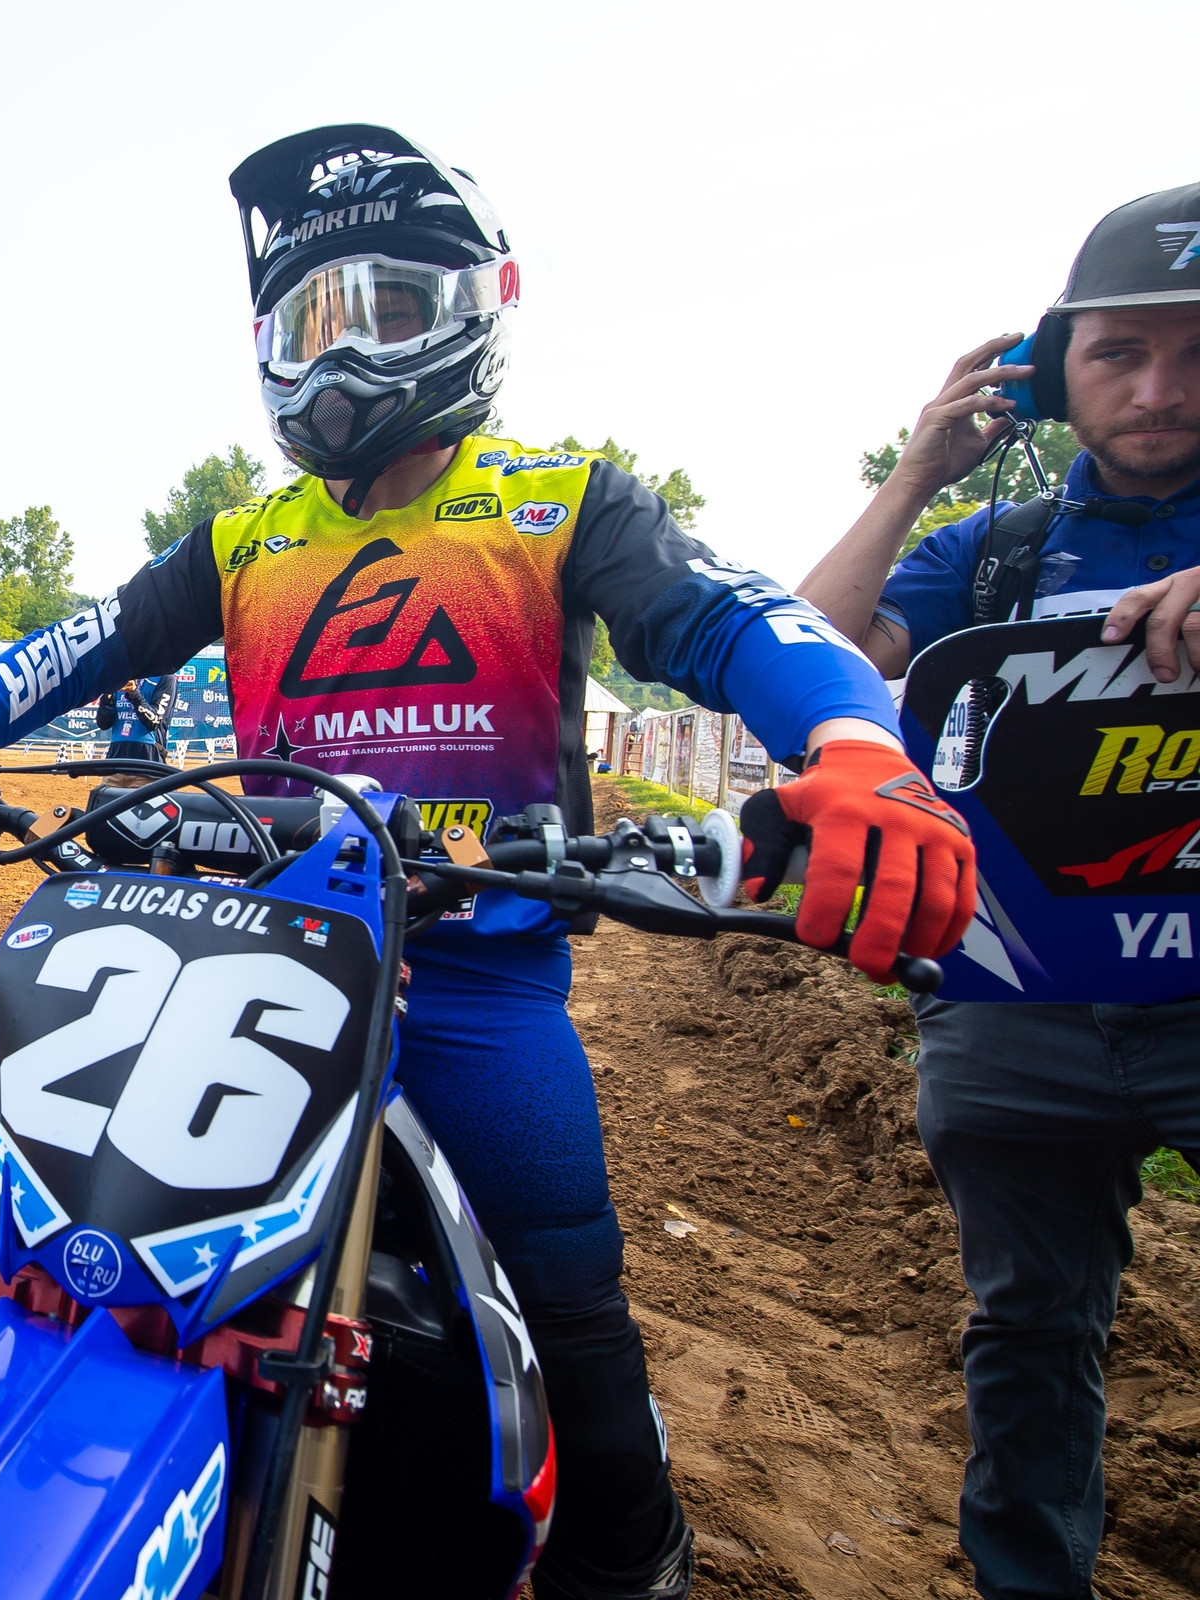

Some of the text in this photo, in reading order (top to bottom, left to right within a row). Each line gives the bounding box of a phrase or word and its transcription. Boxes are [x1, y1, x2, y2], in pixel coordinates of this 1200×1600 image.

[291, 200, 397, 248] MARTIN
[503, 454, 580, 475] YAMAHA
[444, 497, 494, 517] 100%
[511, 507, 561, 523] AMA
[68, 720, 89, 730] INC.
[314, 704, 495, 740] MANLUK
[318, 743, 495, 759] GLOBAL MANUFACTURING SOLUTIONS
[1079, 724, 1200, 796] RO
[102, 884, 271, 935] LUCAS OIL
[288, 915, 331, 935] AMA
[1112, 913, 1194, 958] YA
[304, 931, 328, 943] PRO
[0, 923, 351, 1190] 26
